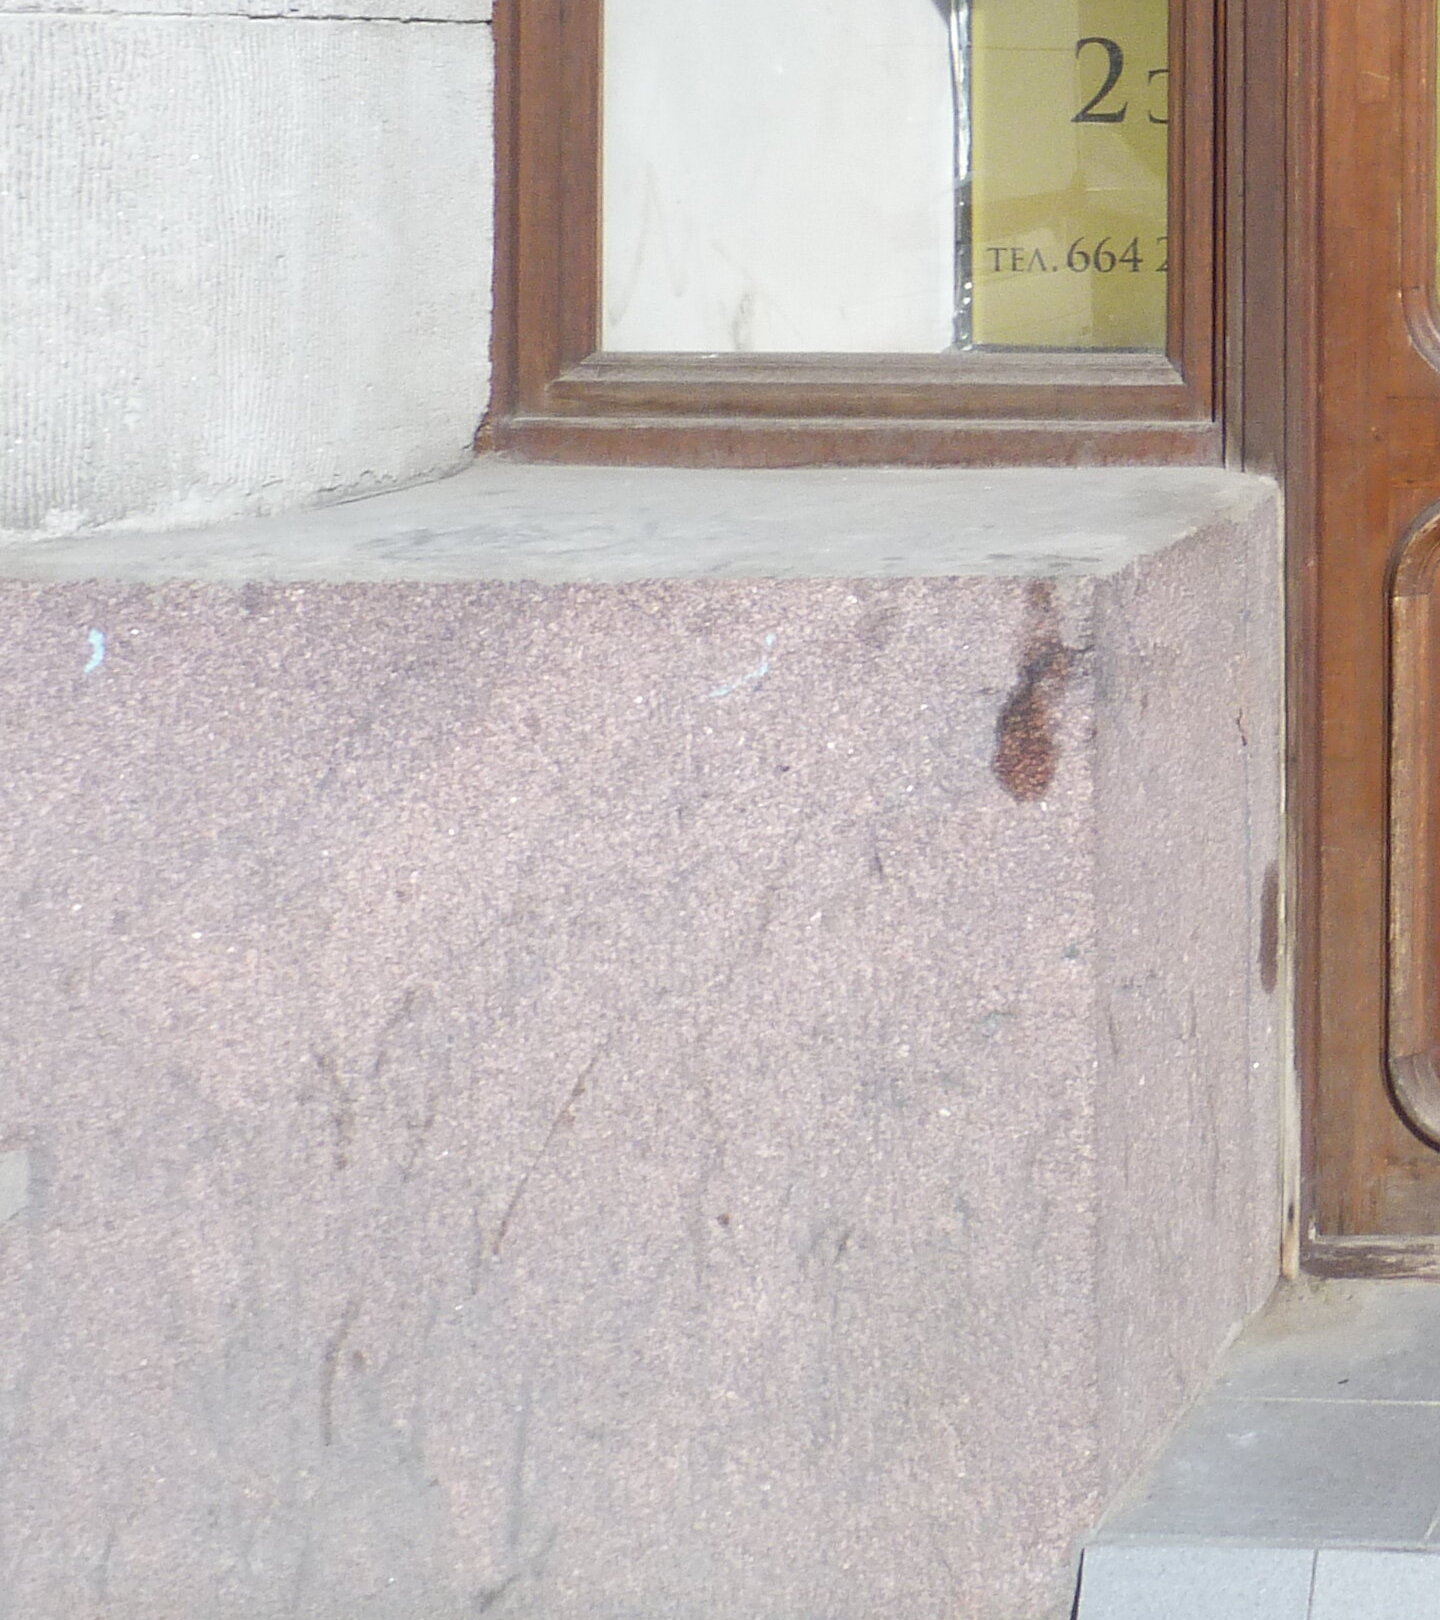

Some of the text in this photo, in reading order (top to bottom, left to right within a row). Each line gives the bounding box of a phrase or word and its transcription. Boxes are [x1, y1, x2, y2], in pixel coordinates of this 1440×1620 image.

[1071, 36, 1128, 124] 2
[986, 246, 1059, 273] ТЕЛ.
[1066, 236, 1144, 274] 664
